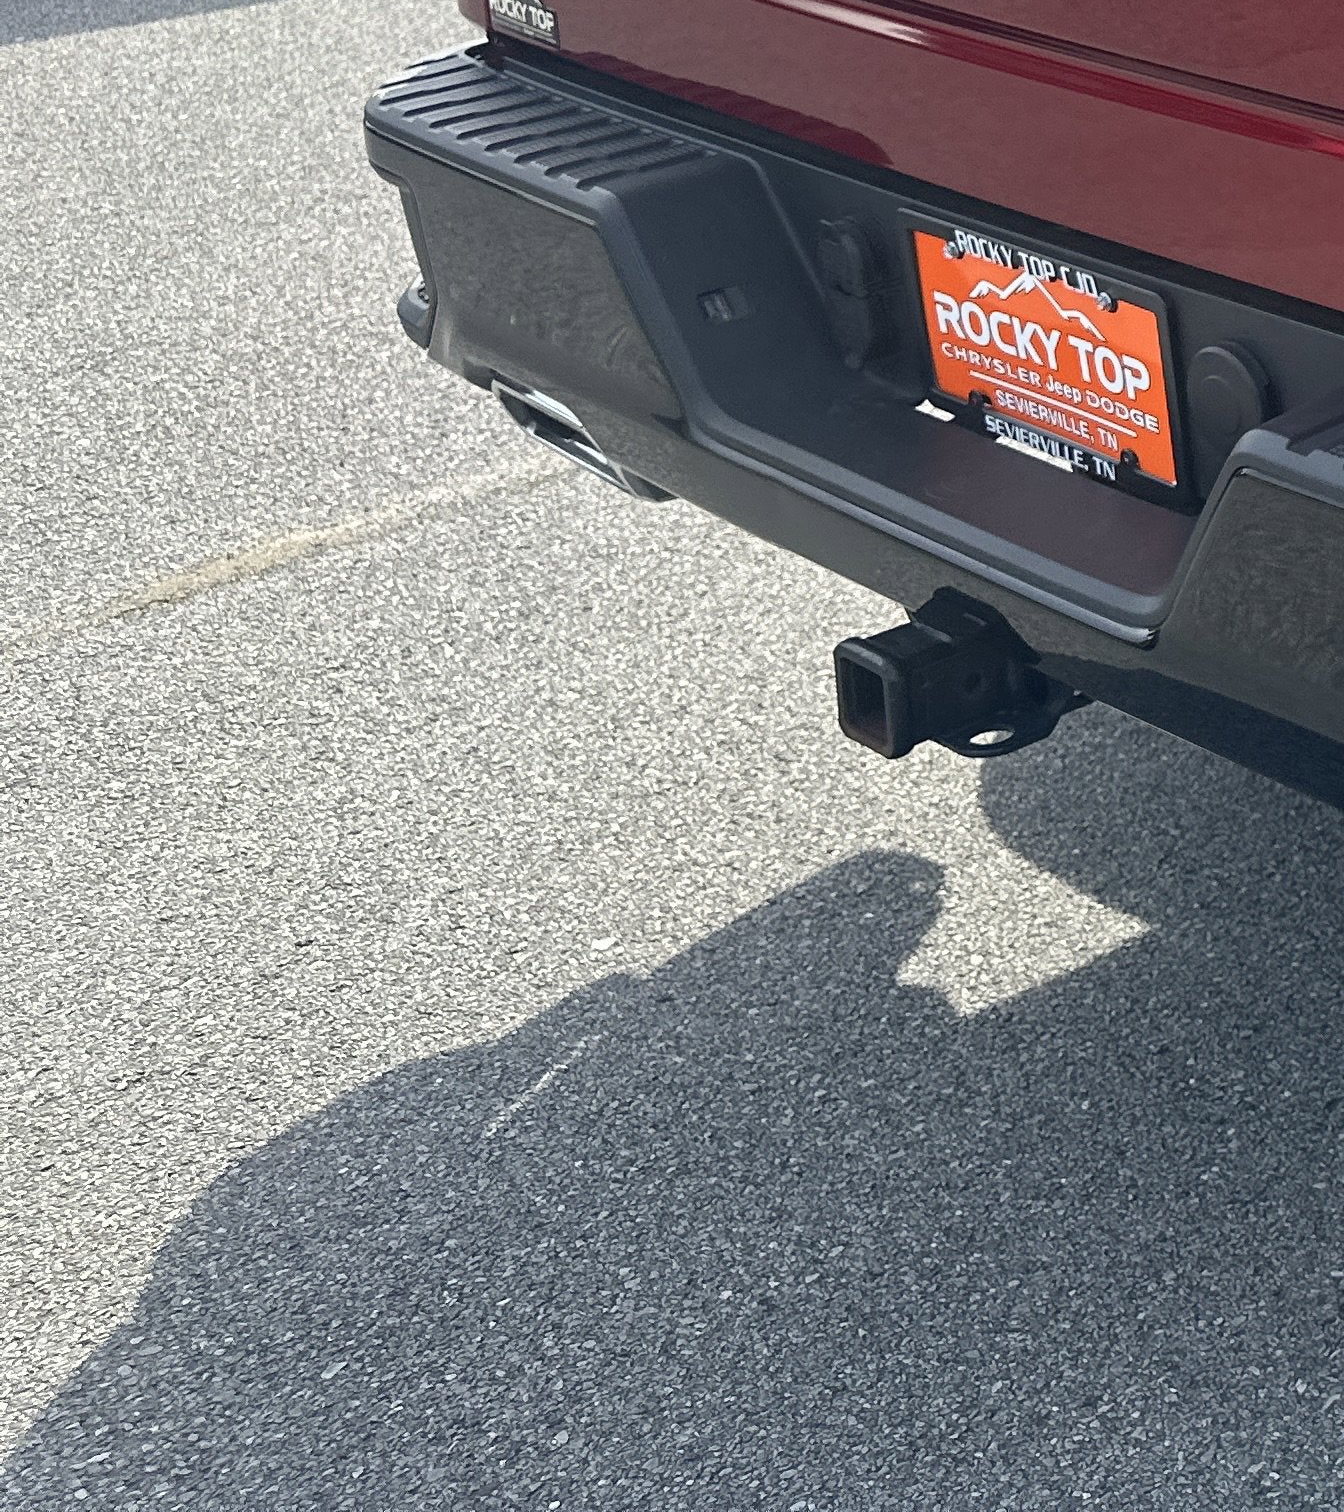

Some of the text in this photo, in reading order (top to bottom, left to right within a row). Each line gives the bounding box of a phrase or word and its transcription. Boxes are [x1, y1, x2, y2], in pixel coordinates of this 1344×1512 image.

[529, 6, 555, 32] TOP
[954, 229, 1013, 269] ROCKY
[1018, 251, 1056, 282] TOP
[932, 290, 1151, 400] ROCKY TOP
[941, 342, 1160, 434] CHRYSLER Jeep DODGE
[995, 390, 1118, 451] SEVIERVILLE, TN
[1092, 455, 1117, 481] TN
